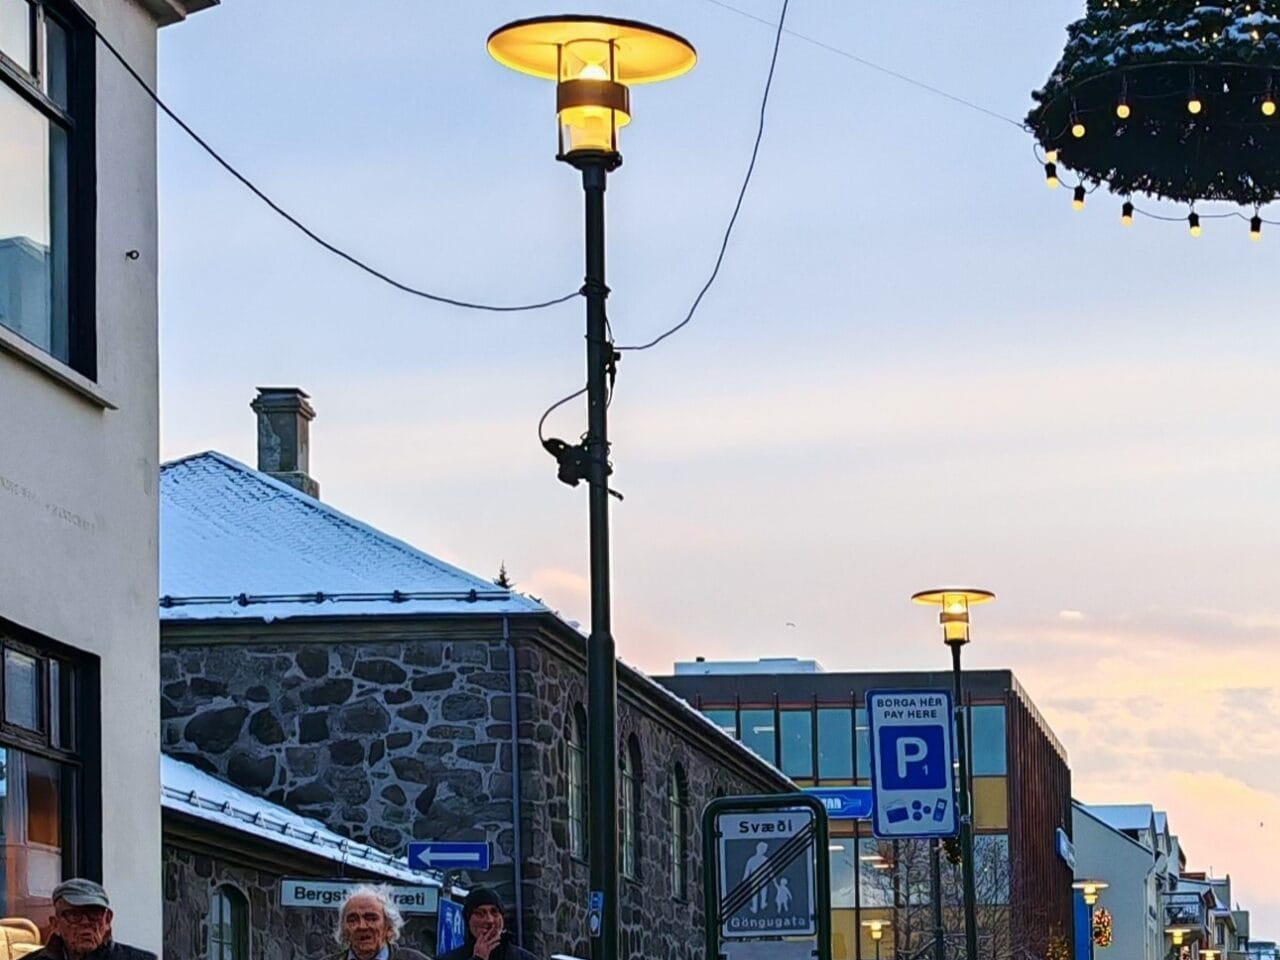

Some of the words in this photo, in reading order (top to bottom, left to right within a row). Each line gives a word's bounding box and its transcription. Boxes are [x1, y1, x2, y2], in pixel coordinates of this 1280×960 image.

[877, 699, 916, 708] BORGA
[884, 711, 904, 719] PAY
[908, 710, 937, 718] HERE
[739, 818, 793, 834] Svæði
[731, 915, 806, 930] Göngugata
